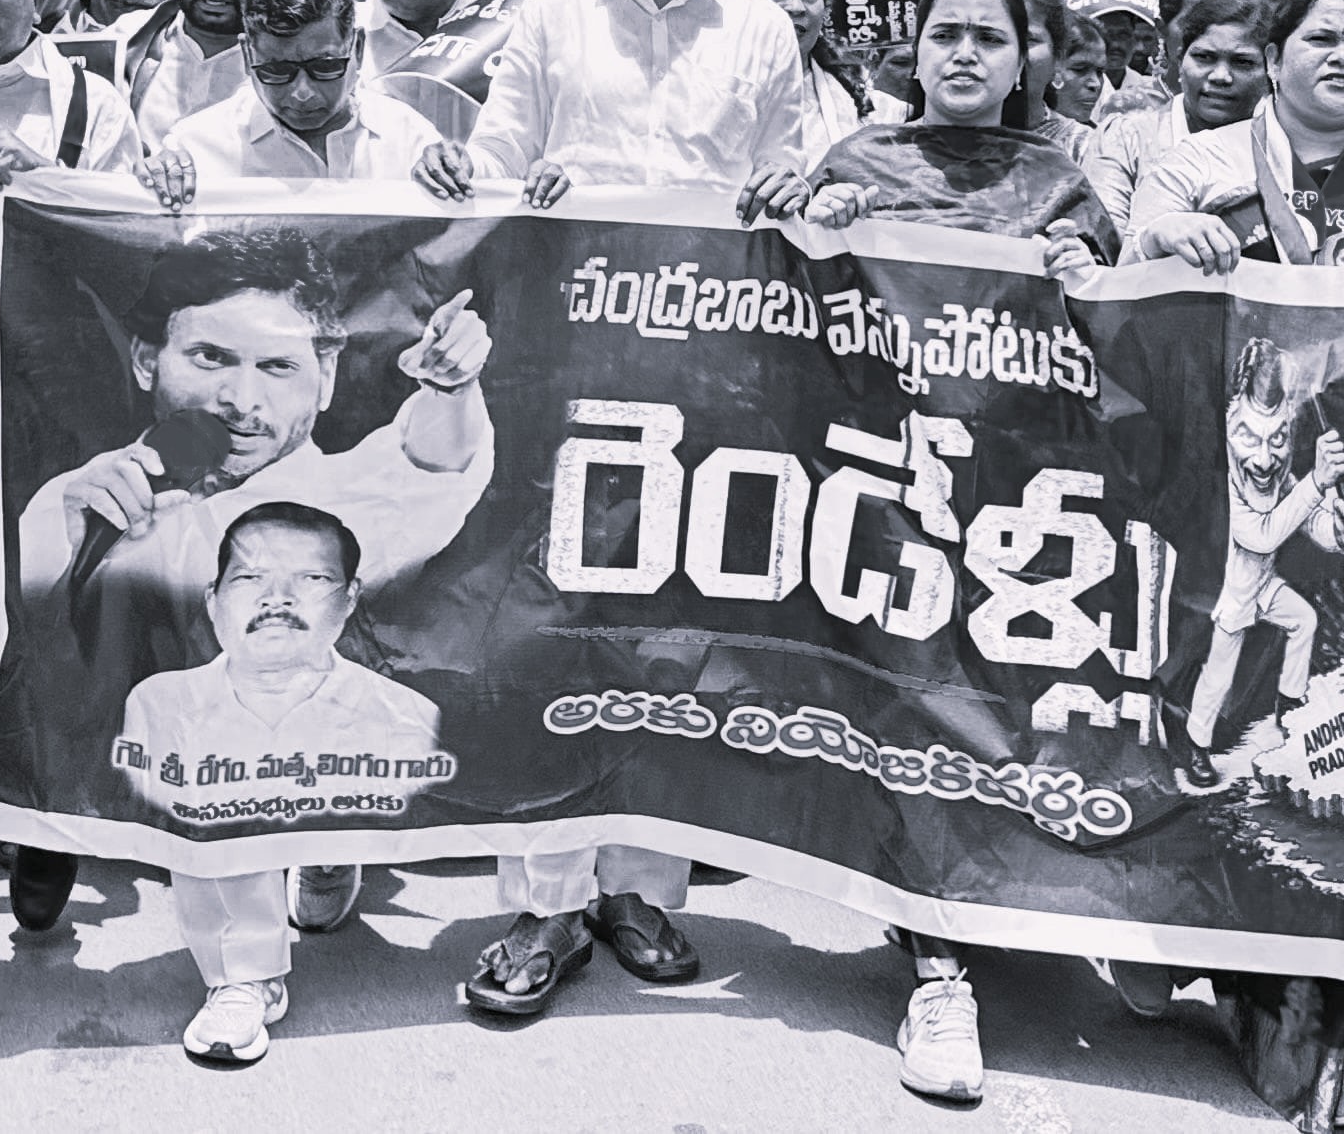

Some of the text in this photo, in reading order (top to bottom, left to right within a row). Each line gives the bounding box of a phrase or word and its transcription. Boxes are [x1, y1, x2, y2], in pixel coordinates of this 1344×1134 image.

[561, 256, 1101, 397] చంద్రబాబు వెన్నుపోటుకు
[543, 398, 1179, 748] రెండేళ్లు
[172, 794, 404, 820] శాసనసభ్యులు అరకు
[394, 752, 453, 779] గారు
[544, 690, 1132, 841] అరకు నియోజకవర్గం
